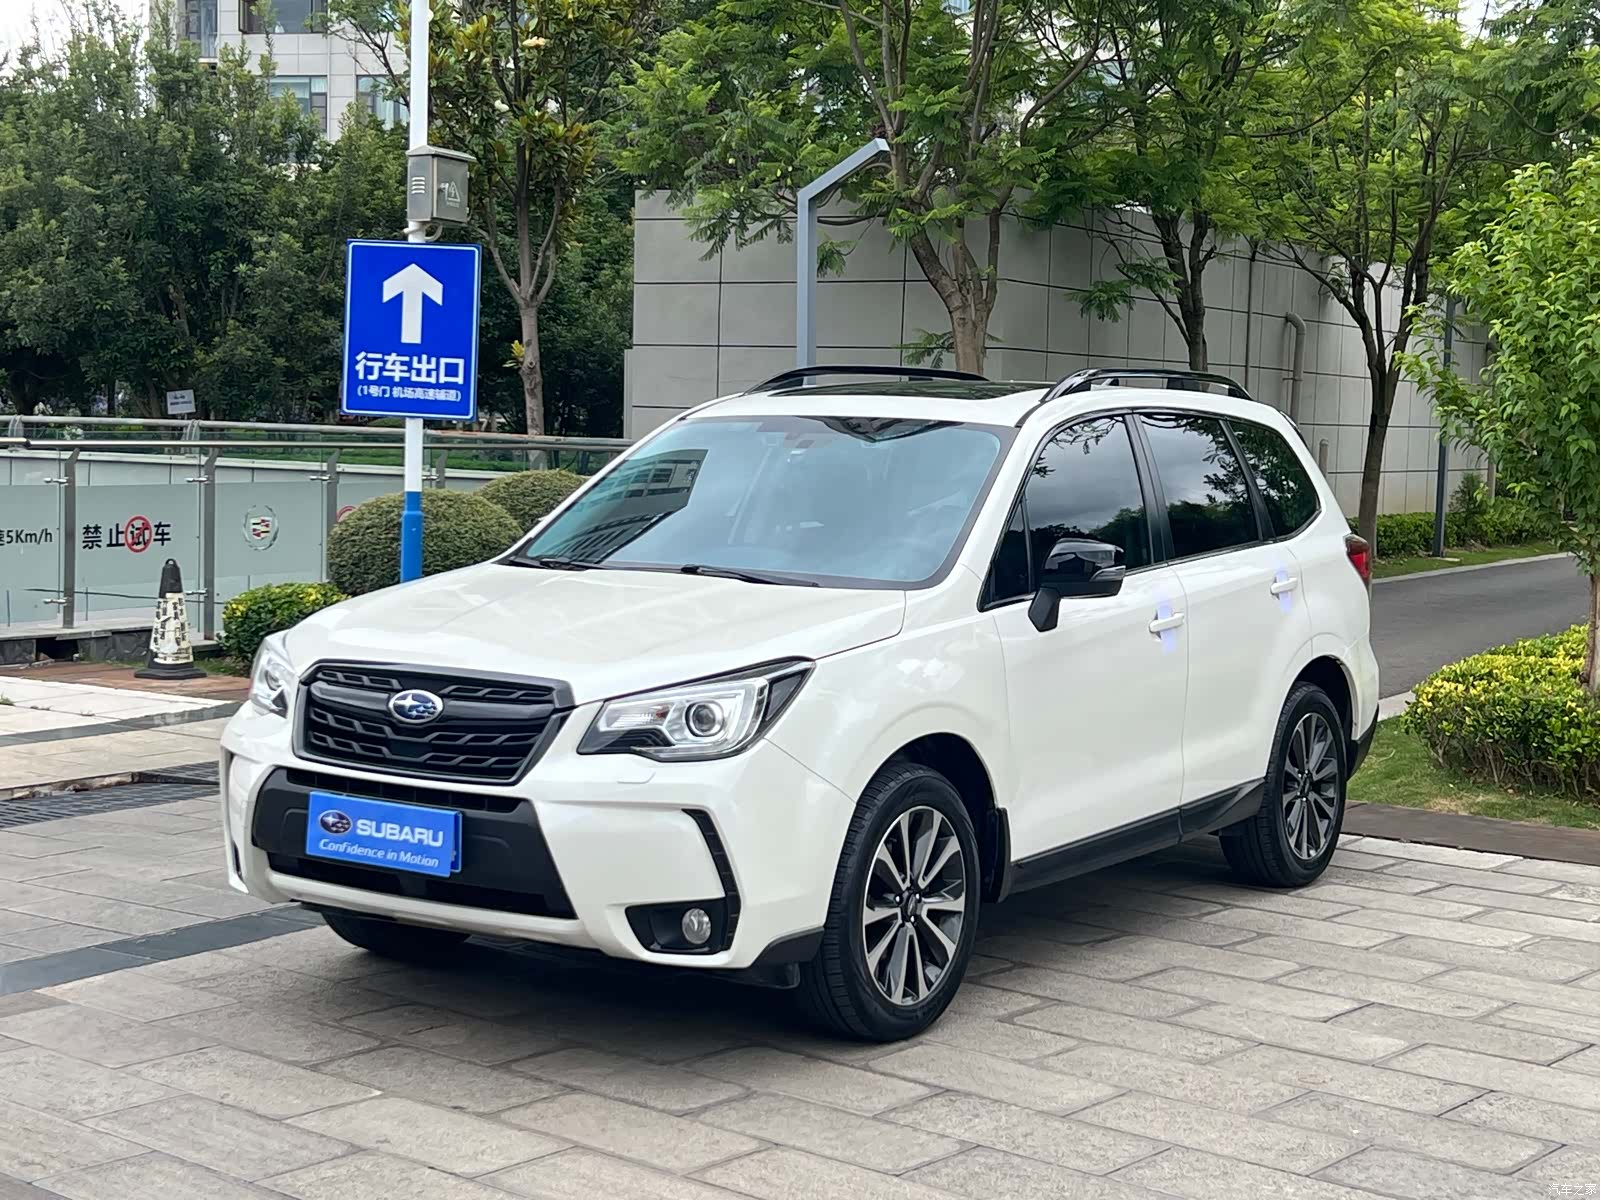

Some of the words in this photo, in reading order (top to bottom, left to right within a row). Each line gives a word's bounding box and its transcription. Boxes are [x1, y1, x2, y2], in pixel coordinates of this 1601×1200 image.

[355, 351, 465, 385] 行车出口
[82, 521, 172, 550] 禁止试车
[356, 819, 444, 847] SUBARU
[319, 838, 385, 859] Confidence
[386, 848, 399, 860] in
[400, 850, 440, 868] Motion
